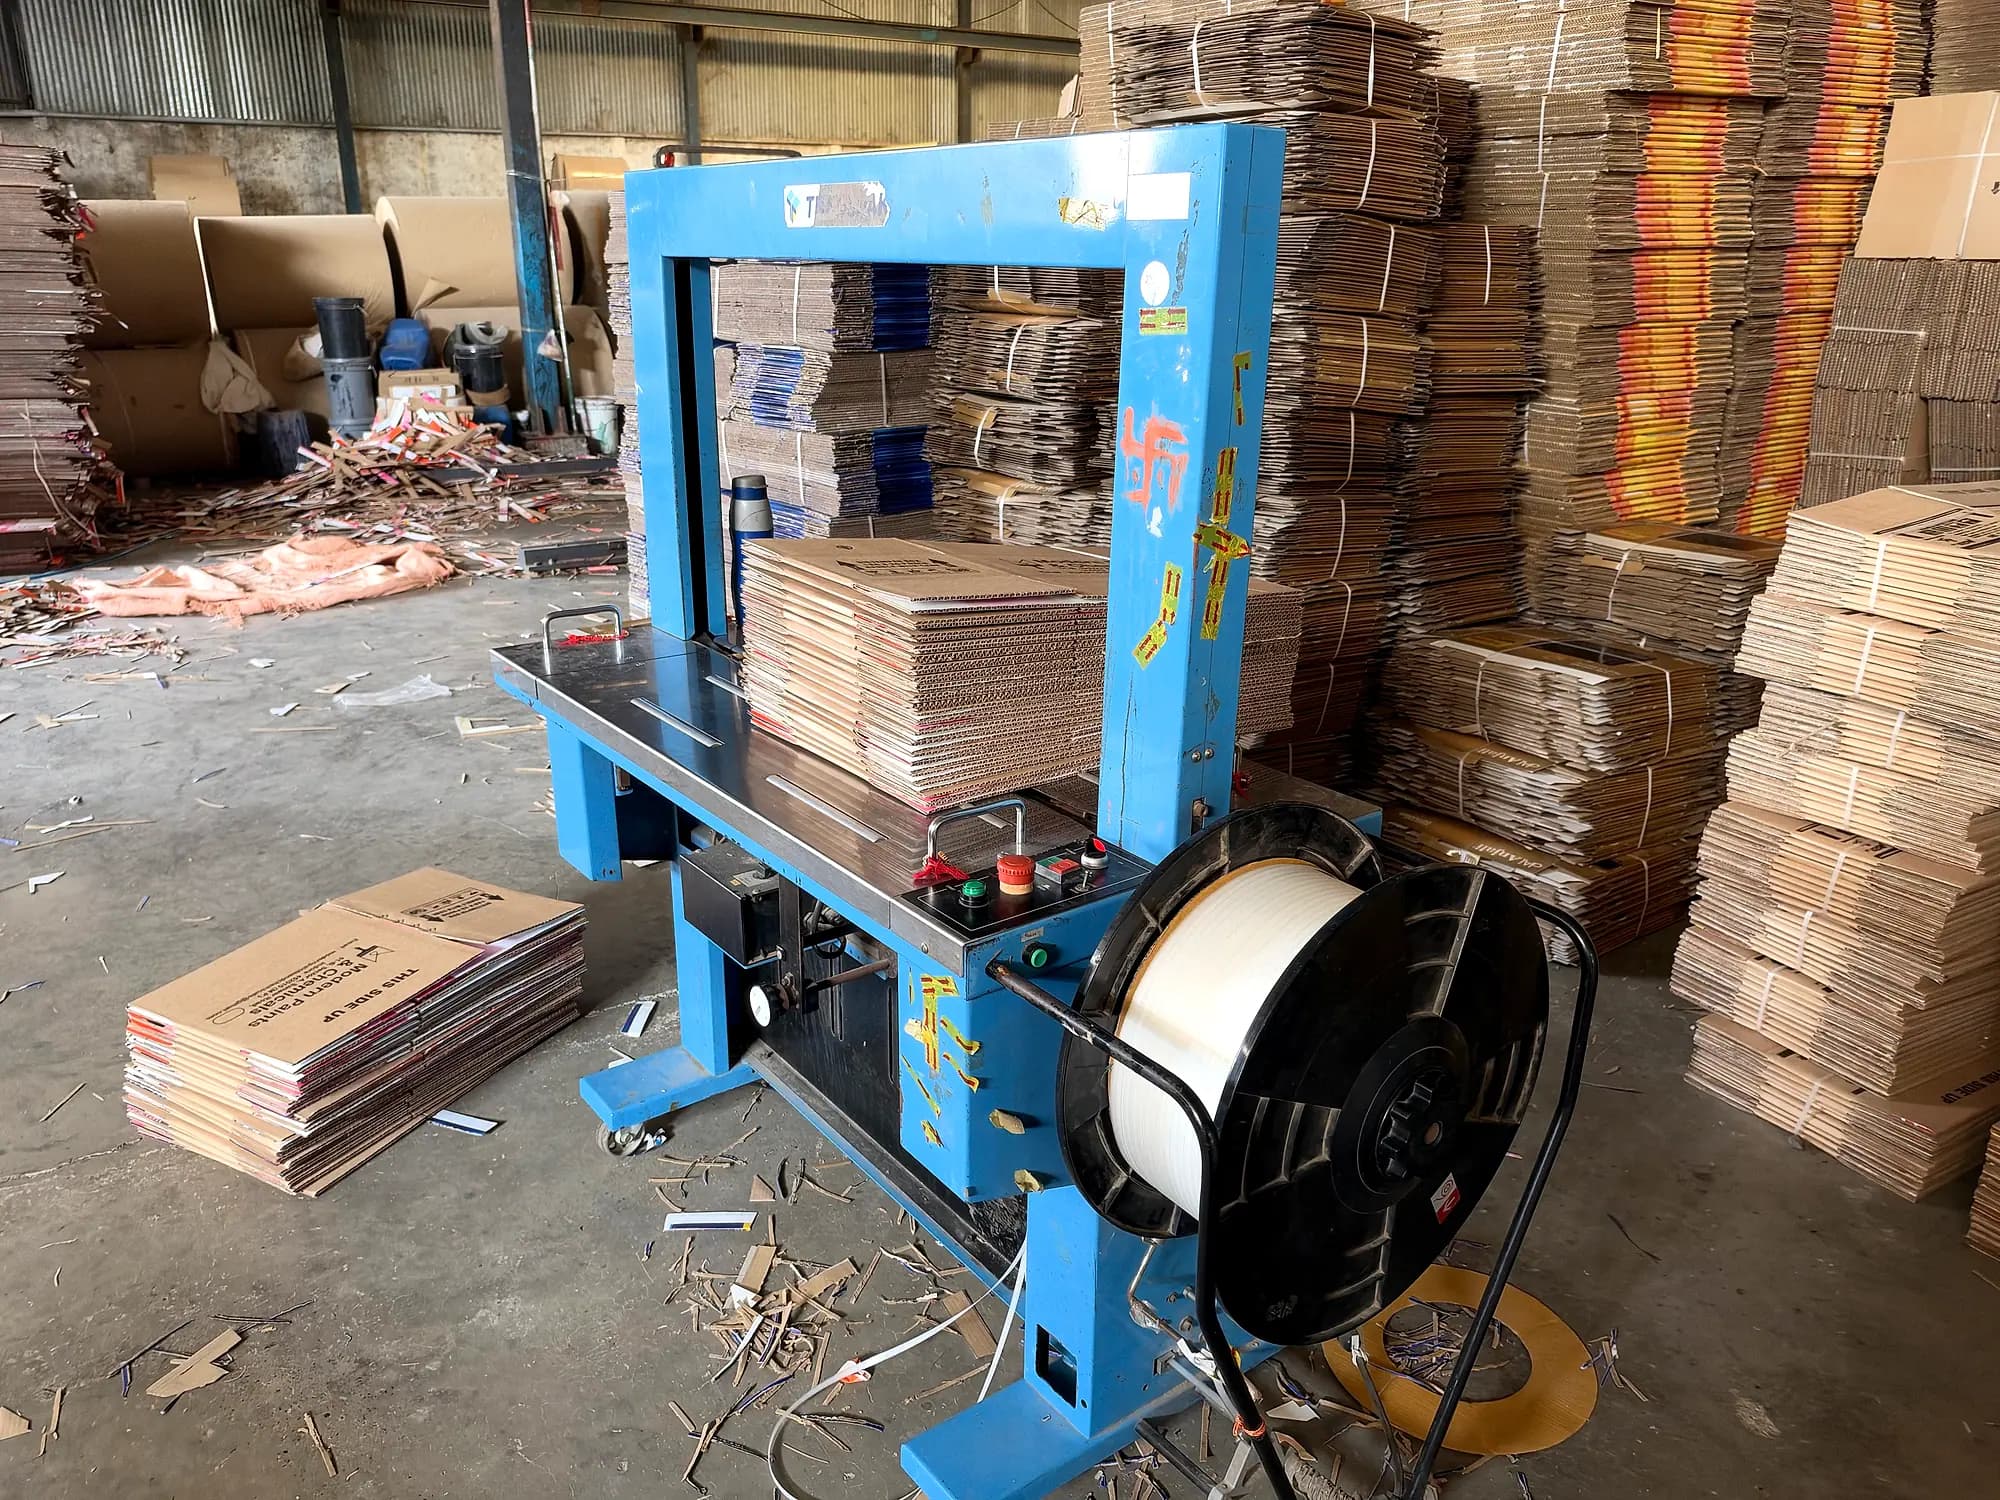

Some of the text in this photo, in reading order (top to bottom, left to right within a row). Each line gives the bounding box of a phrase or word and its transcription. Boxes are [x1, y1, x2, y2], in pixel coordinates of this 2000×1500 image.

[303, 963, 368, 998] Modern
[337, 959, 353, 968] &
[249, 968, 338, 1015] Chemicals
[322, 967, 420, 1023] THIS SIDE UP
[248, 998, 305, 1028] Paints
